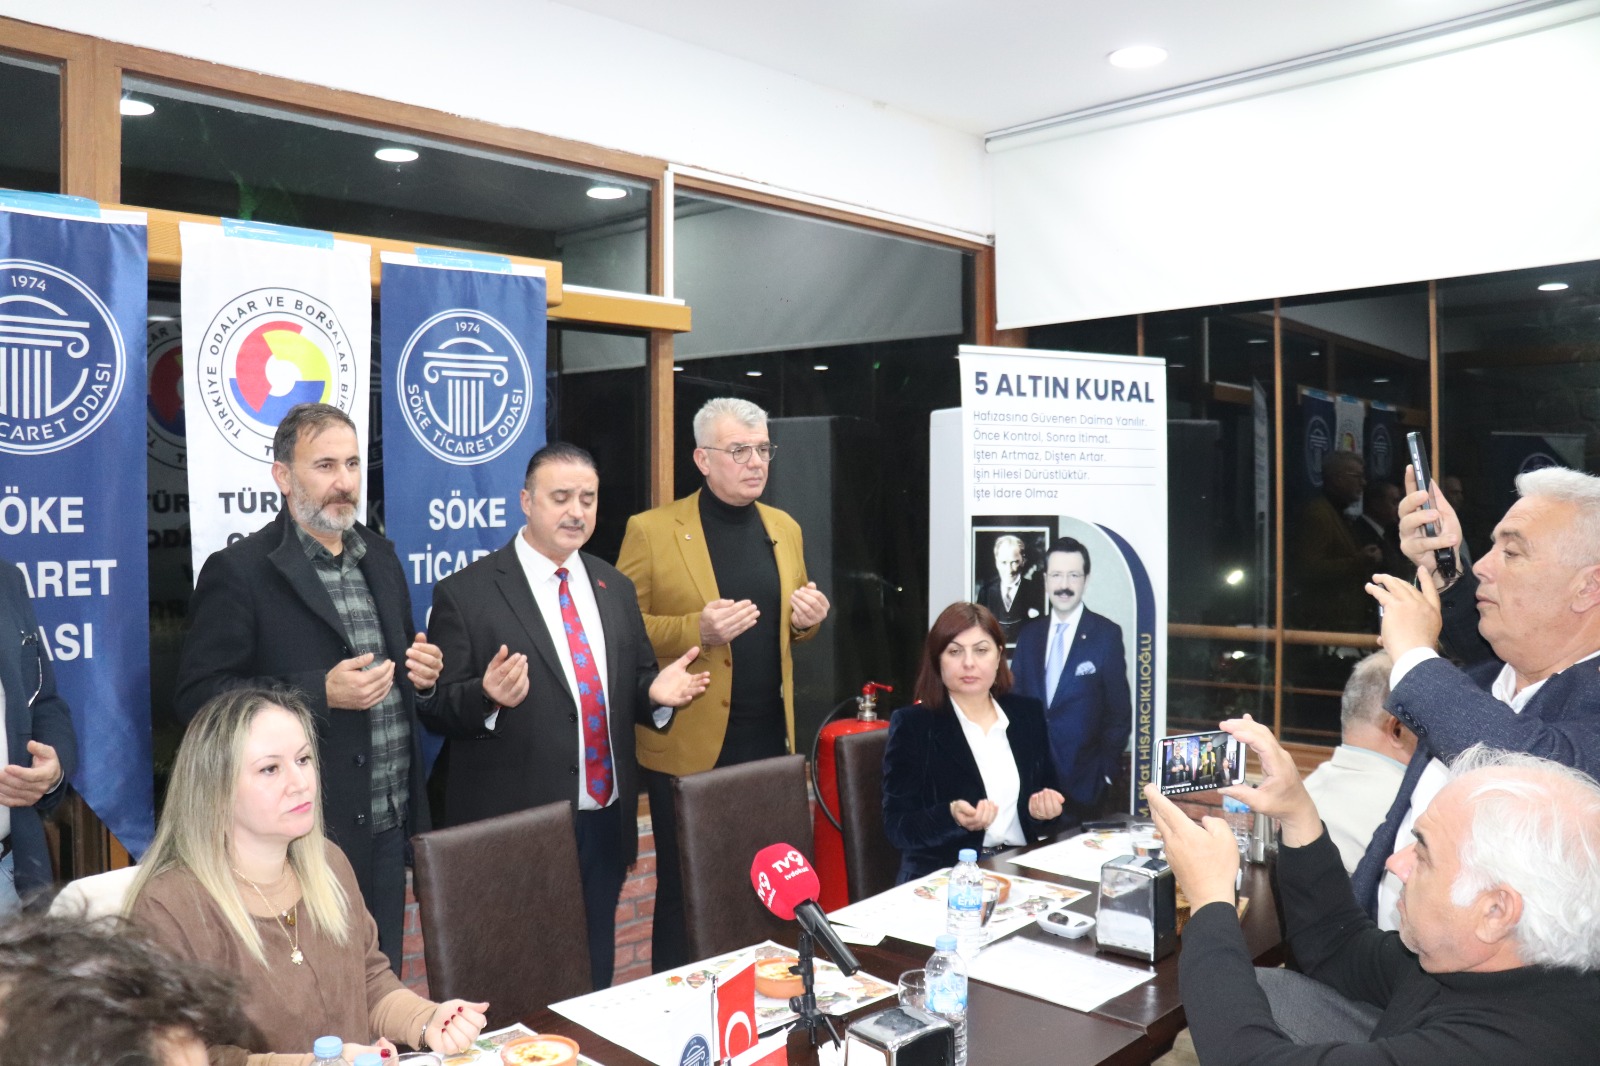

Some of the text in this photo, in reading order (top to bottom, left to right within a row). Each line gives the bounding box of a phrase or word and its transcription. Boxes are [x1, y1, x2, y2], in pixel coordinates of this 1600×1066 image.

[11, 275, 47, 292] 1974
[265, 295, 285, 307] VE
[209, 300, 259, 356] ODALAR
[294, 299, 348, 374] BORSALAR
[455, 321, 481, 334] 1974
[0, 362, 112, 441] CARET ODASI
[334, 383, 349, 413] BİR
[974, 371, 1155, 404] 5 ALTIN KURAL
[206, 365, 242, 440] TÜRKİYE
[407, 384, 524, 455] SÖKE TİCARET ODASI
[973, 410, 1029, 422] Hafızasına
[1031, 412, 1078, 424] Güvenen
[1080, 414, 1114, 425] Daima
[973, 427, 1001, 440] Önce
[1046, 431, 1077, 443] Sonra
[993, 467, 1022, 480] Hilesi
[218, 487, 285, 515] TÜR
[1025, 488, 1059, 499] Olmaz
[0, 486, 85, 535] ÖKE
[428, 490, 507, 531] SÖKE
[771, 850, 804, 873] TV9
[784, 866, 809, 881] tvdokuz
